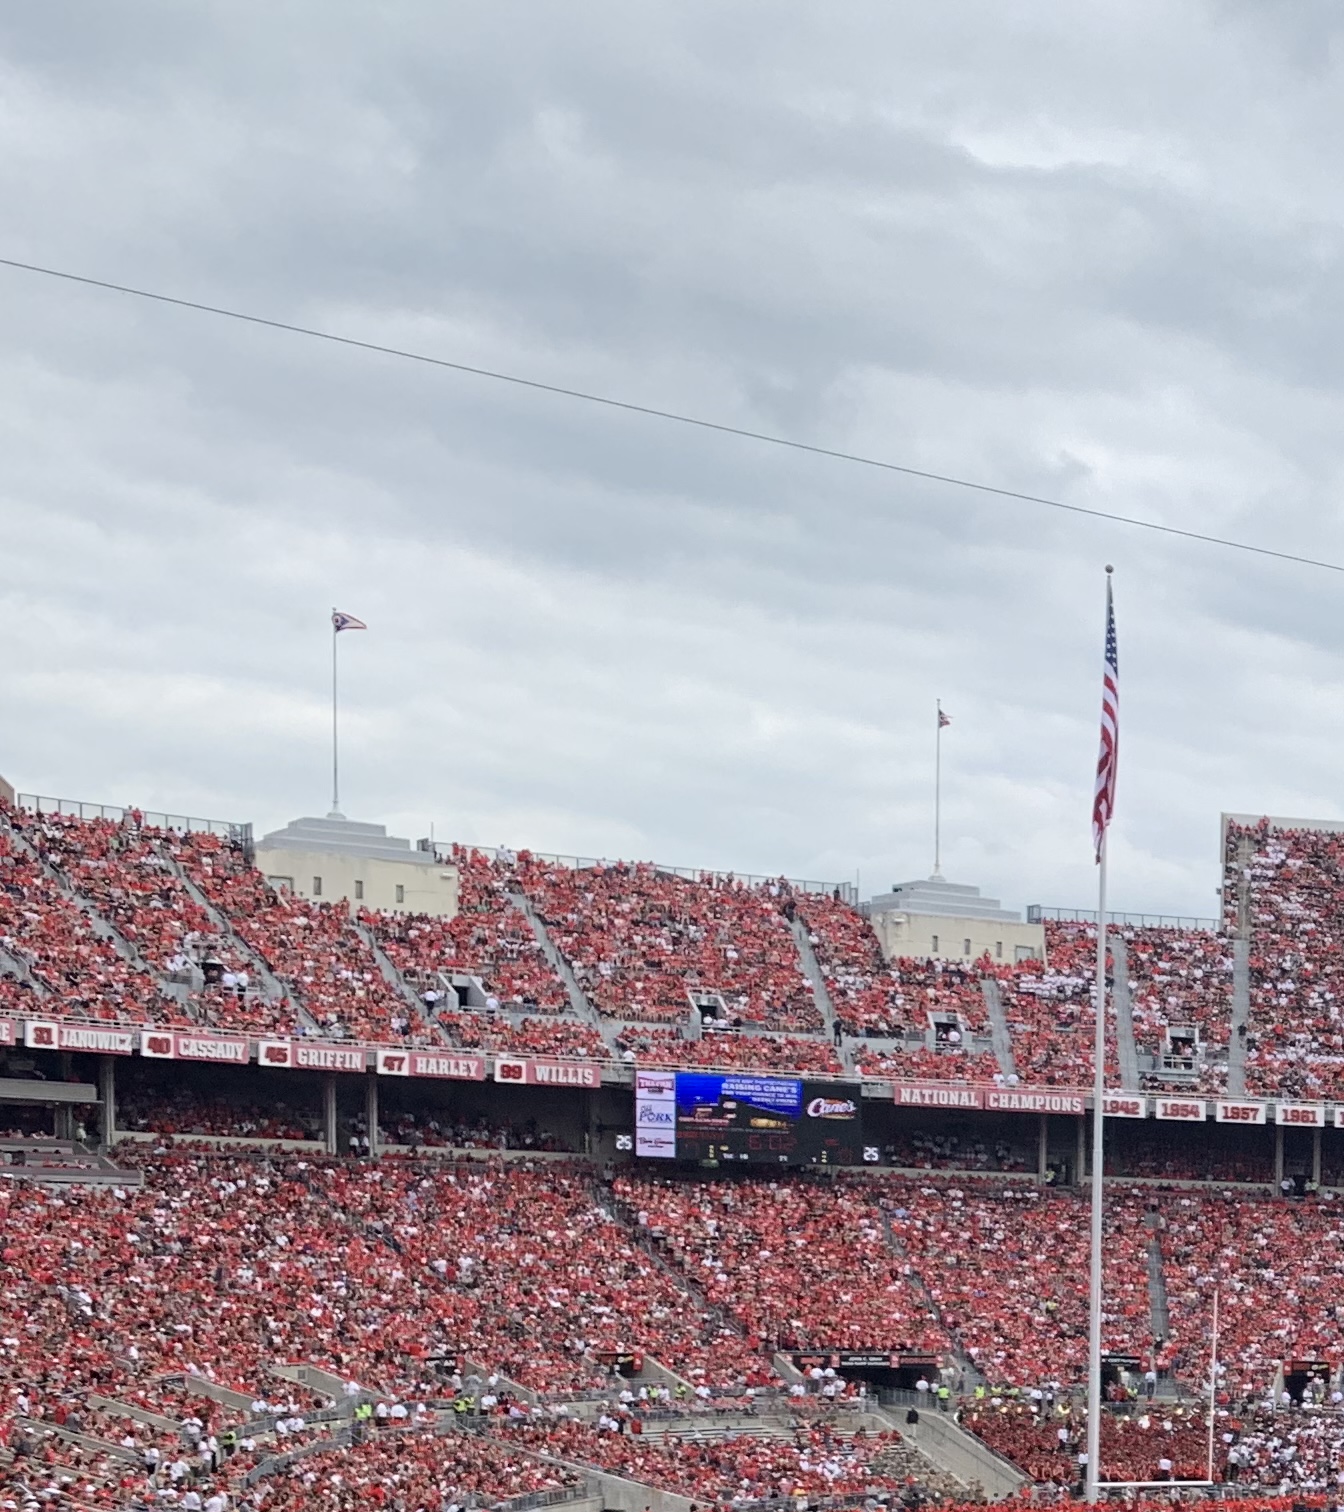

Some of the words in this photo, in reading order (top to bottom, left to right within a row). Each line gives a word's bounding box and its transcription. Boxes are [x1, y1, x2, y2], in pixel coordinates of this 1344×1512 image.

[60, 1029, 132, 1051] JANOWICZ
[179, 1038, 245, 1060] CASSADY
[297, 1048, 362, 1069] GRIFFIN
[416, 1056, 478, 1077] HARLEY
[534, 1065, 593, 1085] WILLIS
[900, 1088, 979, 1107] NATIONAL
[989, 1092, 1082, 1113] CHAMPIONS
[1222, 1105, 1259, 1121] 1957
